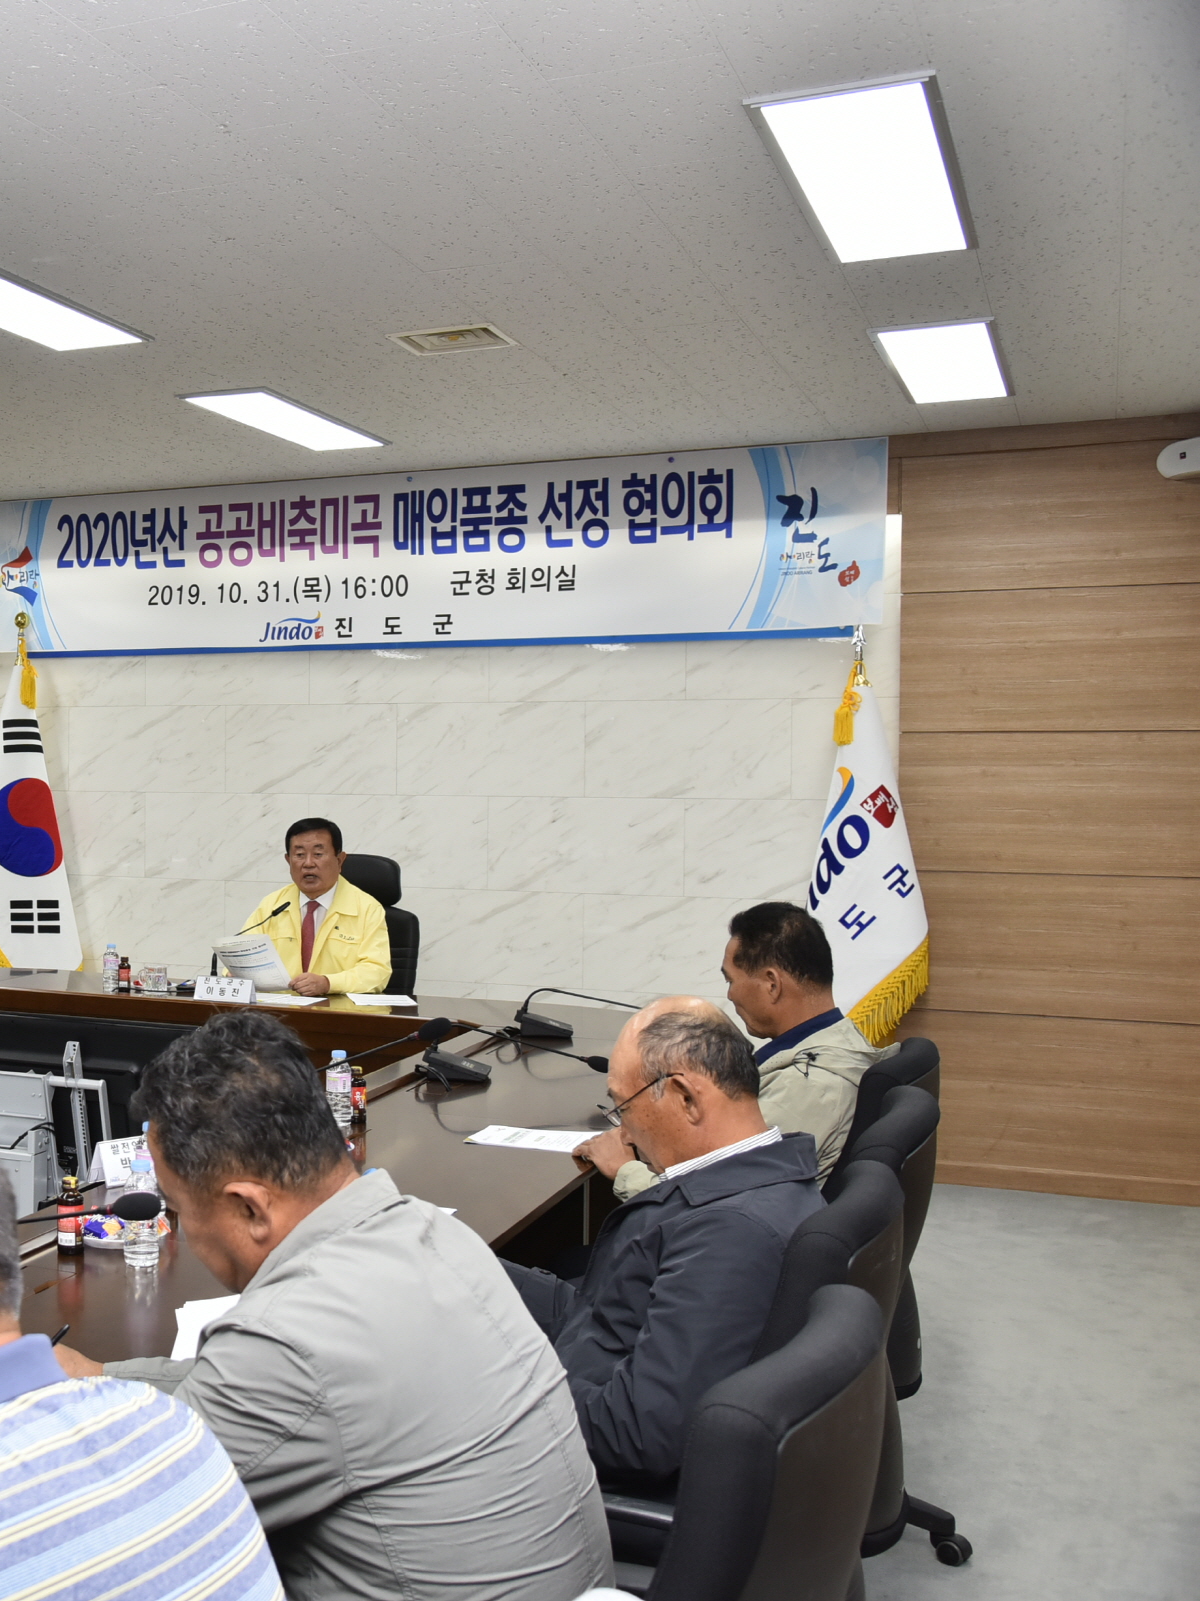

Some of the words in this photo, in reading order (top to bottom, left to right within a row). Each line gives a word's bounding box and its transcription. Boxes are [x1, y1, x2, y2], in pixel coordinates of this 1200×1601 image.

[56, 505, 189, 570] 2020년산
[195, 493, 383, 569] 공공비축미곡
[392, 483, 529, 556] 매입품종
[537, 476, 610, 549] 선정
[621, 468, 734, 545] 협의회
[147, 583, 207, 606] 2019.
[217, 582, 248, 605] 10.
[257, 575, 331, 604] 31.(목)
[341, 574, 409, 600] 16:00
[450, 568, 495, 597] 군청
[506, 564, 576, 594] 회의실
[259, 621, 313, 643] Jindo
